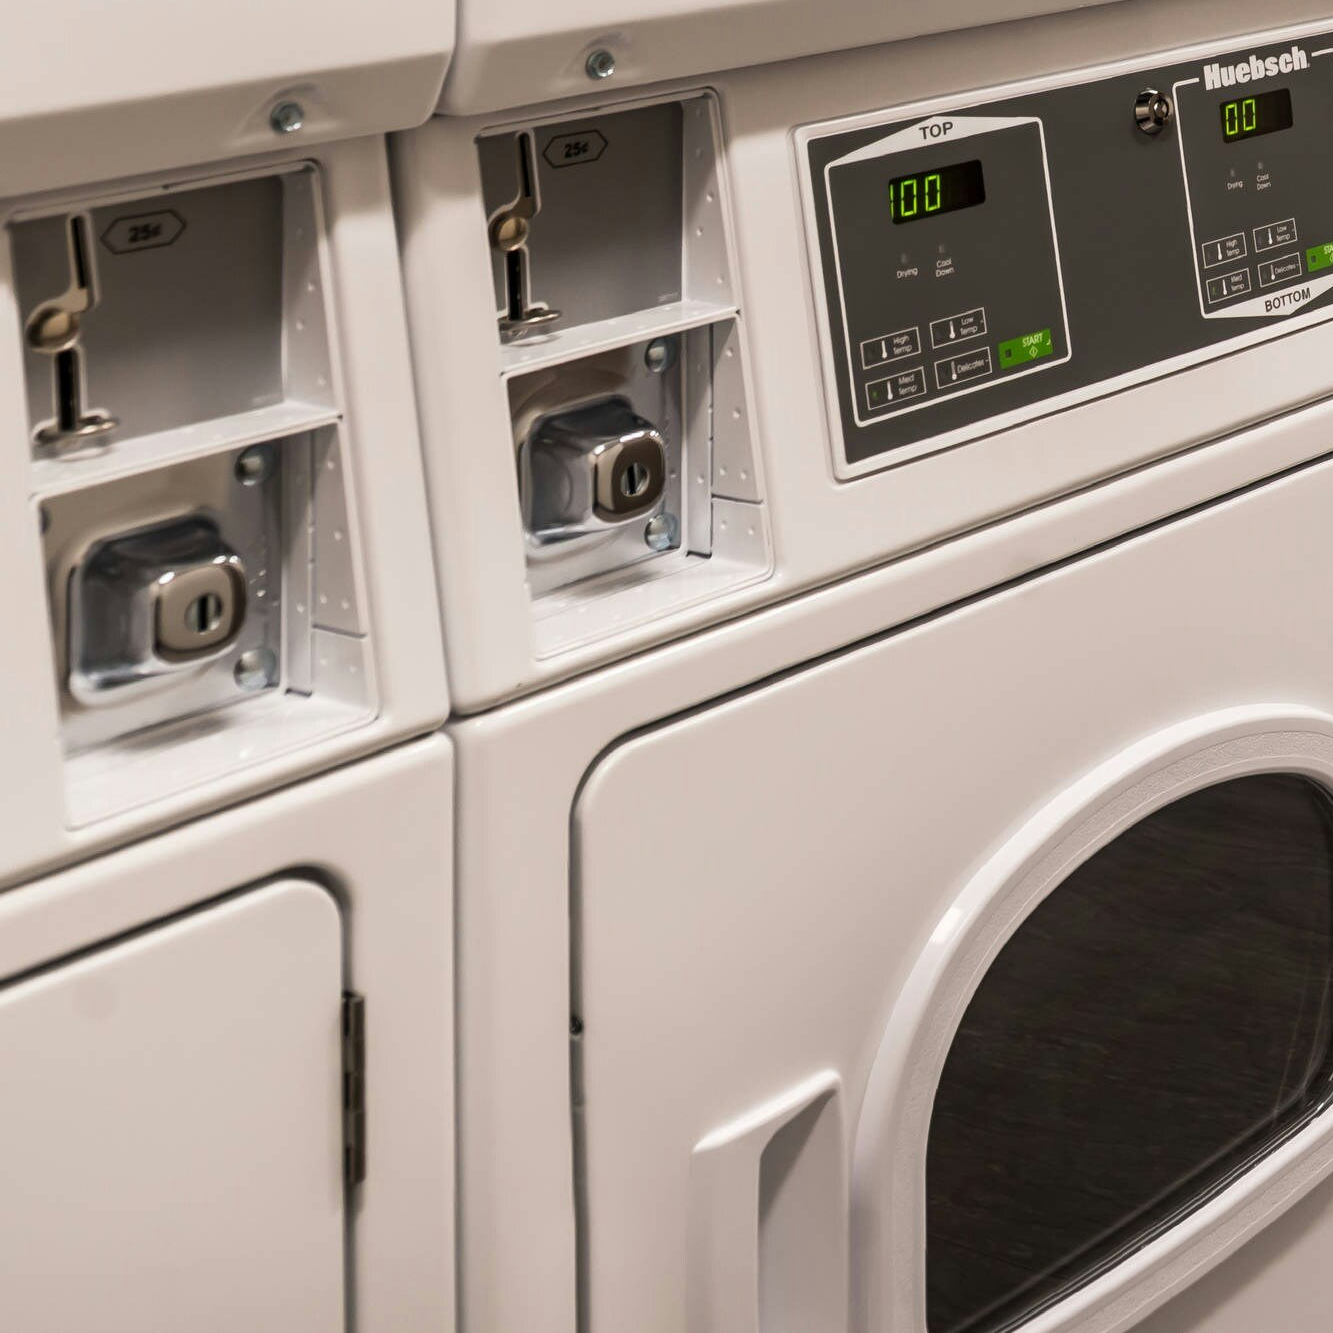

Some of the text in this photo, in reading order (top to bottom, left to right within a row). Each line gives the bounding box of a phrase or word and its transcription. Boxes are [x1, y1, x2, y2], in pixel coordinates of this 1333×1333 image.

[1203, 46, 1308, 90] Huebsch
[1226, 99, 1256, 135] 00
[919, 122, 954, 140] TOP
[936, 258, 952, 268] Cool
[897, 267, 918, 279] Drying
[936, 267, 954, 278] Down
[1264, 287, 1311, 313] BOTTOM
[961, 317, 974, 326] Low
[893, 335, 910, 346] High
[1022, 333, 1043, 347] START
